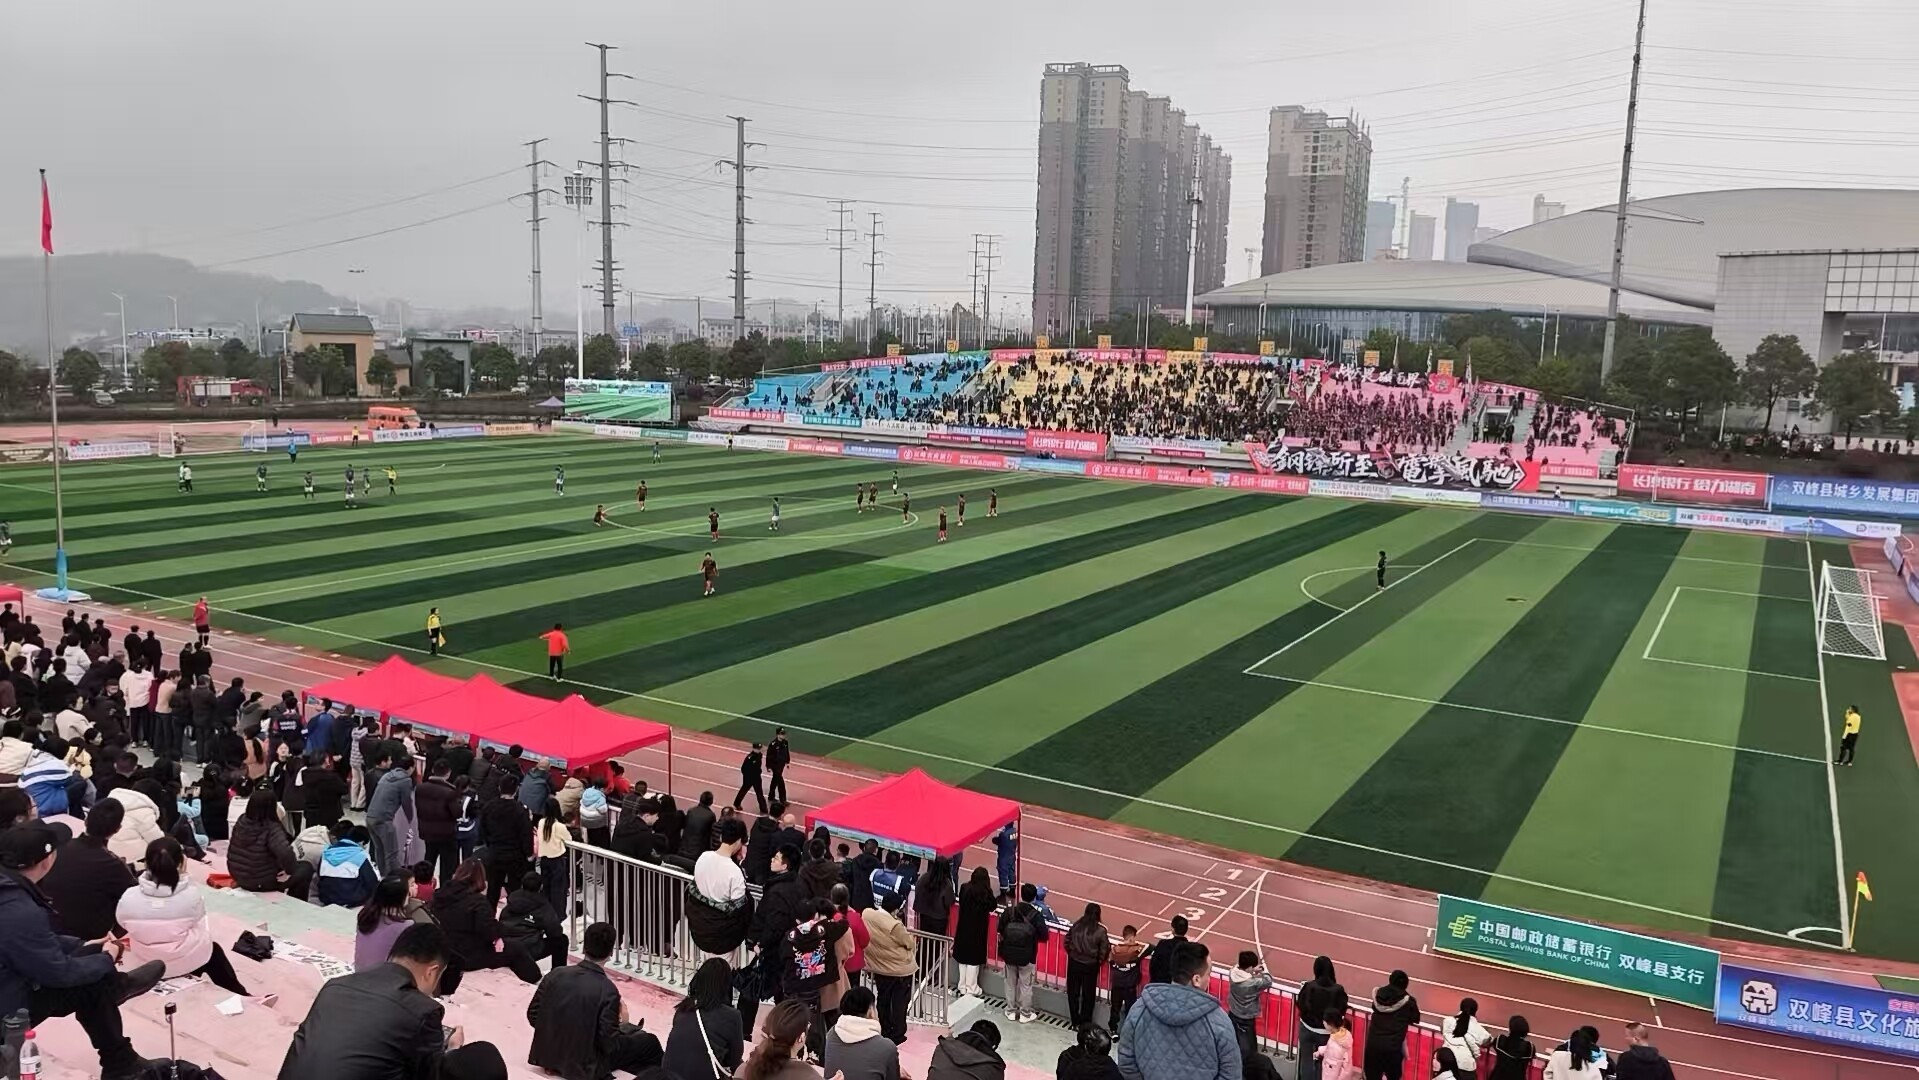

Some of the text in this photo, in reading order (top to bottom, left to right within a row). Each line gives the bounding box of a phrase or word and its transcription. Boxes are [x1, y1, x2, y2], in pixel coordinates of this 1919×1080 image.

[1632, 474, 1691, 490] 长沙银行
[1791, 481, 1919, 503] 双峰县城乡发展集团
[1226, 868, 1243, 881] 1
[1199, 887, 1227, 902] 2
[1178, 906, 1206, 921] 3
[1478, 935, 1508, 947] POSTAL
[1510, 942, 1544, 955] SAVINGS
[1546, 950, 1568, 960] BANK
[1584, 959, 1610, 970] CHINA
[1479, 920, 1705, 985] 中国邮政储蓄银行 双峰县支行
